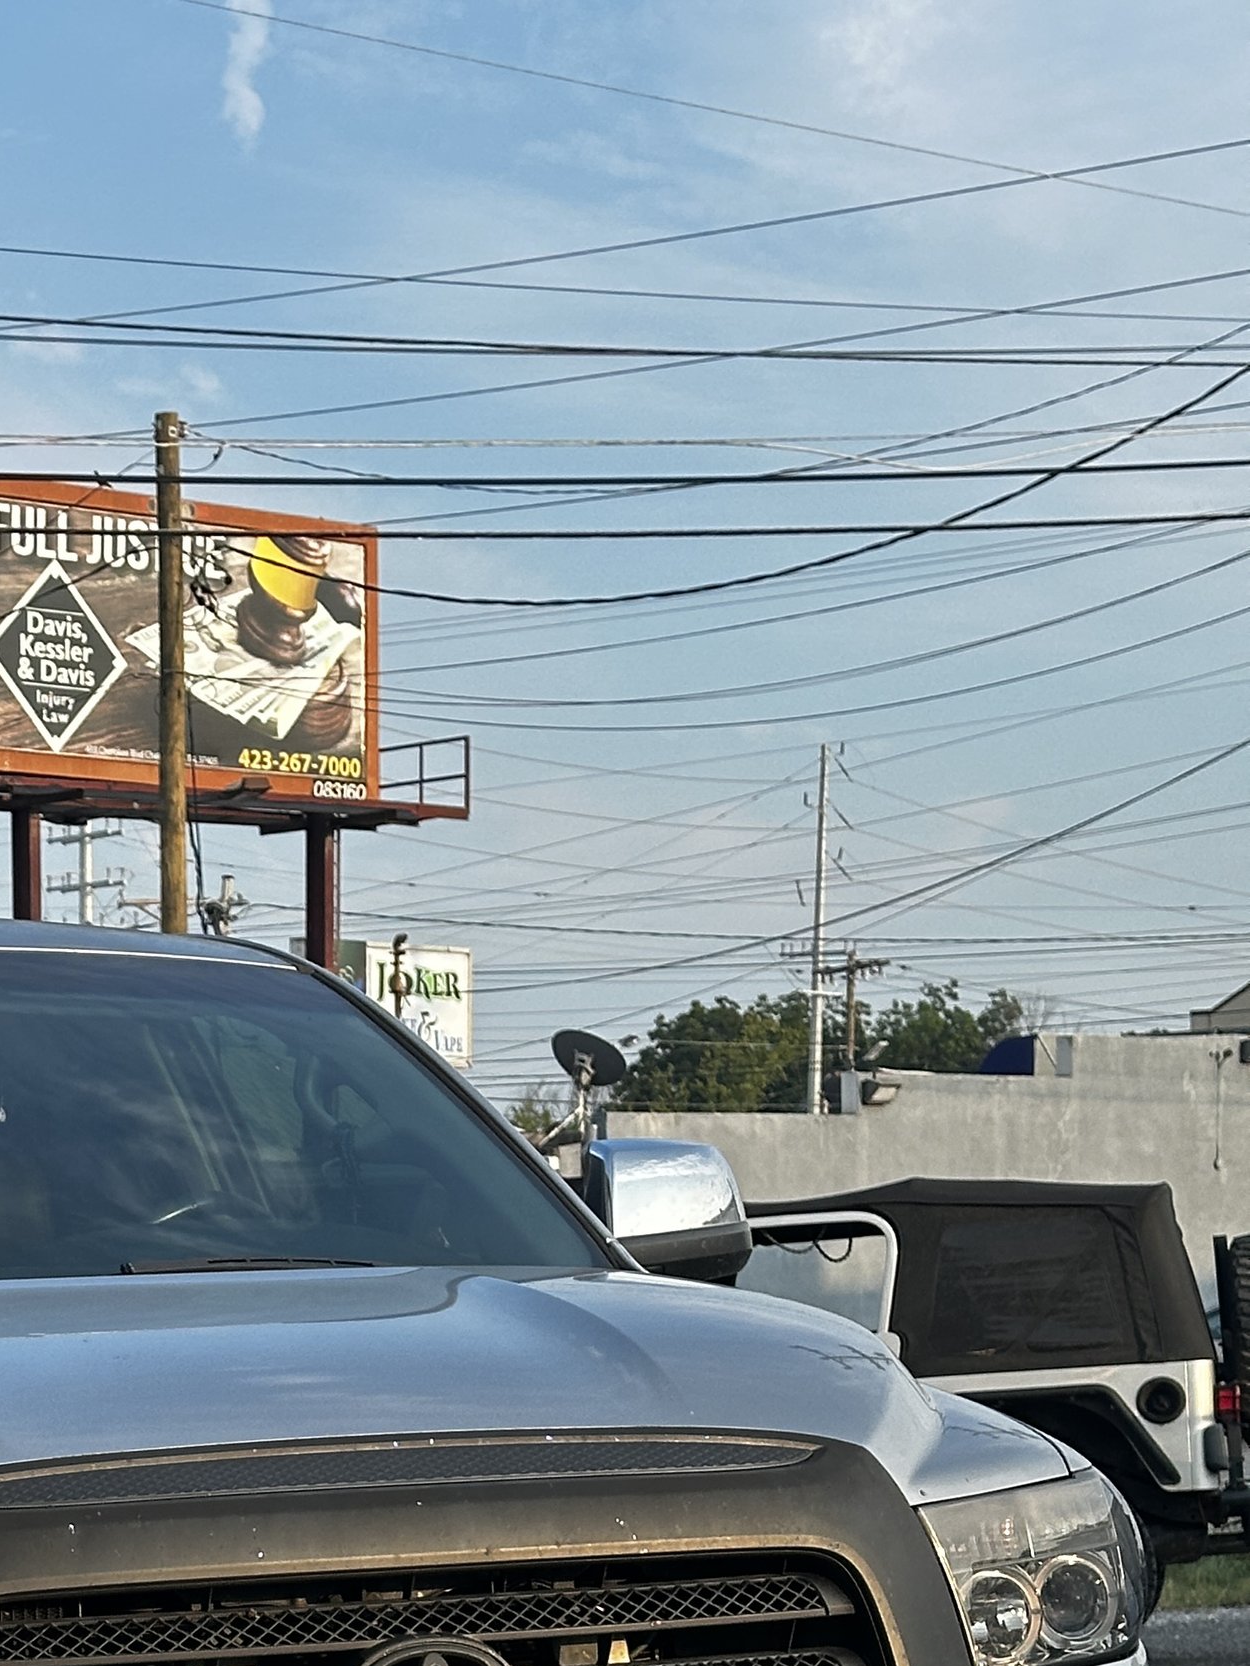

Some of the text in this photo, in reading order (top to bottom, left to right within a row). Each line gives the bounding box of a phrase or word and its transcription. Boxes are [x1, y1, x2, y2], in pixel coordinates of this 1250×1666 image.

[86, 515, 227, 580] JUSCE
[26, 610, 88, 644] Davis,
[19, 632, 94, 663] Kessler
[17, 656, 96, 687] & Davis
[36, 689, 76, 711] Injury
[42, 707, 70, 723] Law
[238, 748, 362, 779] 423-267-7000
[313, 780, 367, 801] 083160
[376, 962, 461, 1001] JOKER
